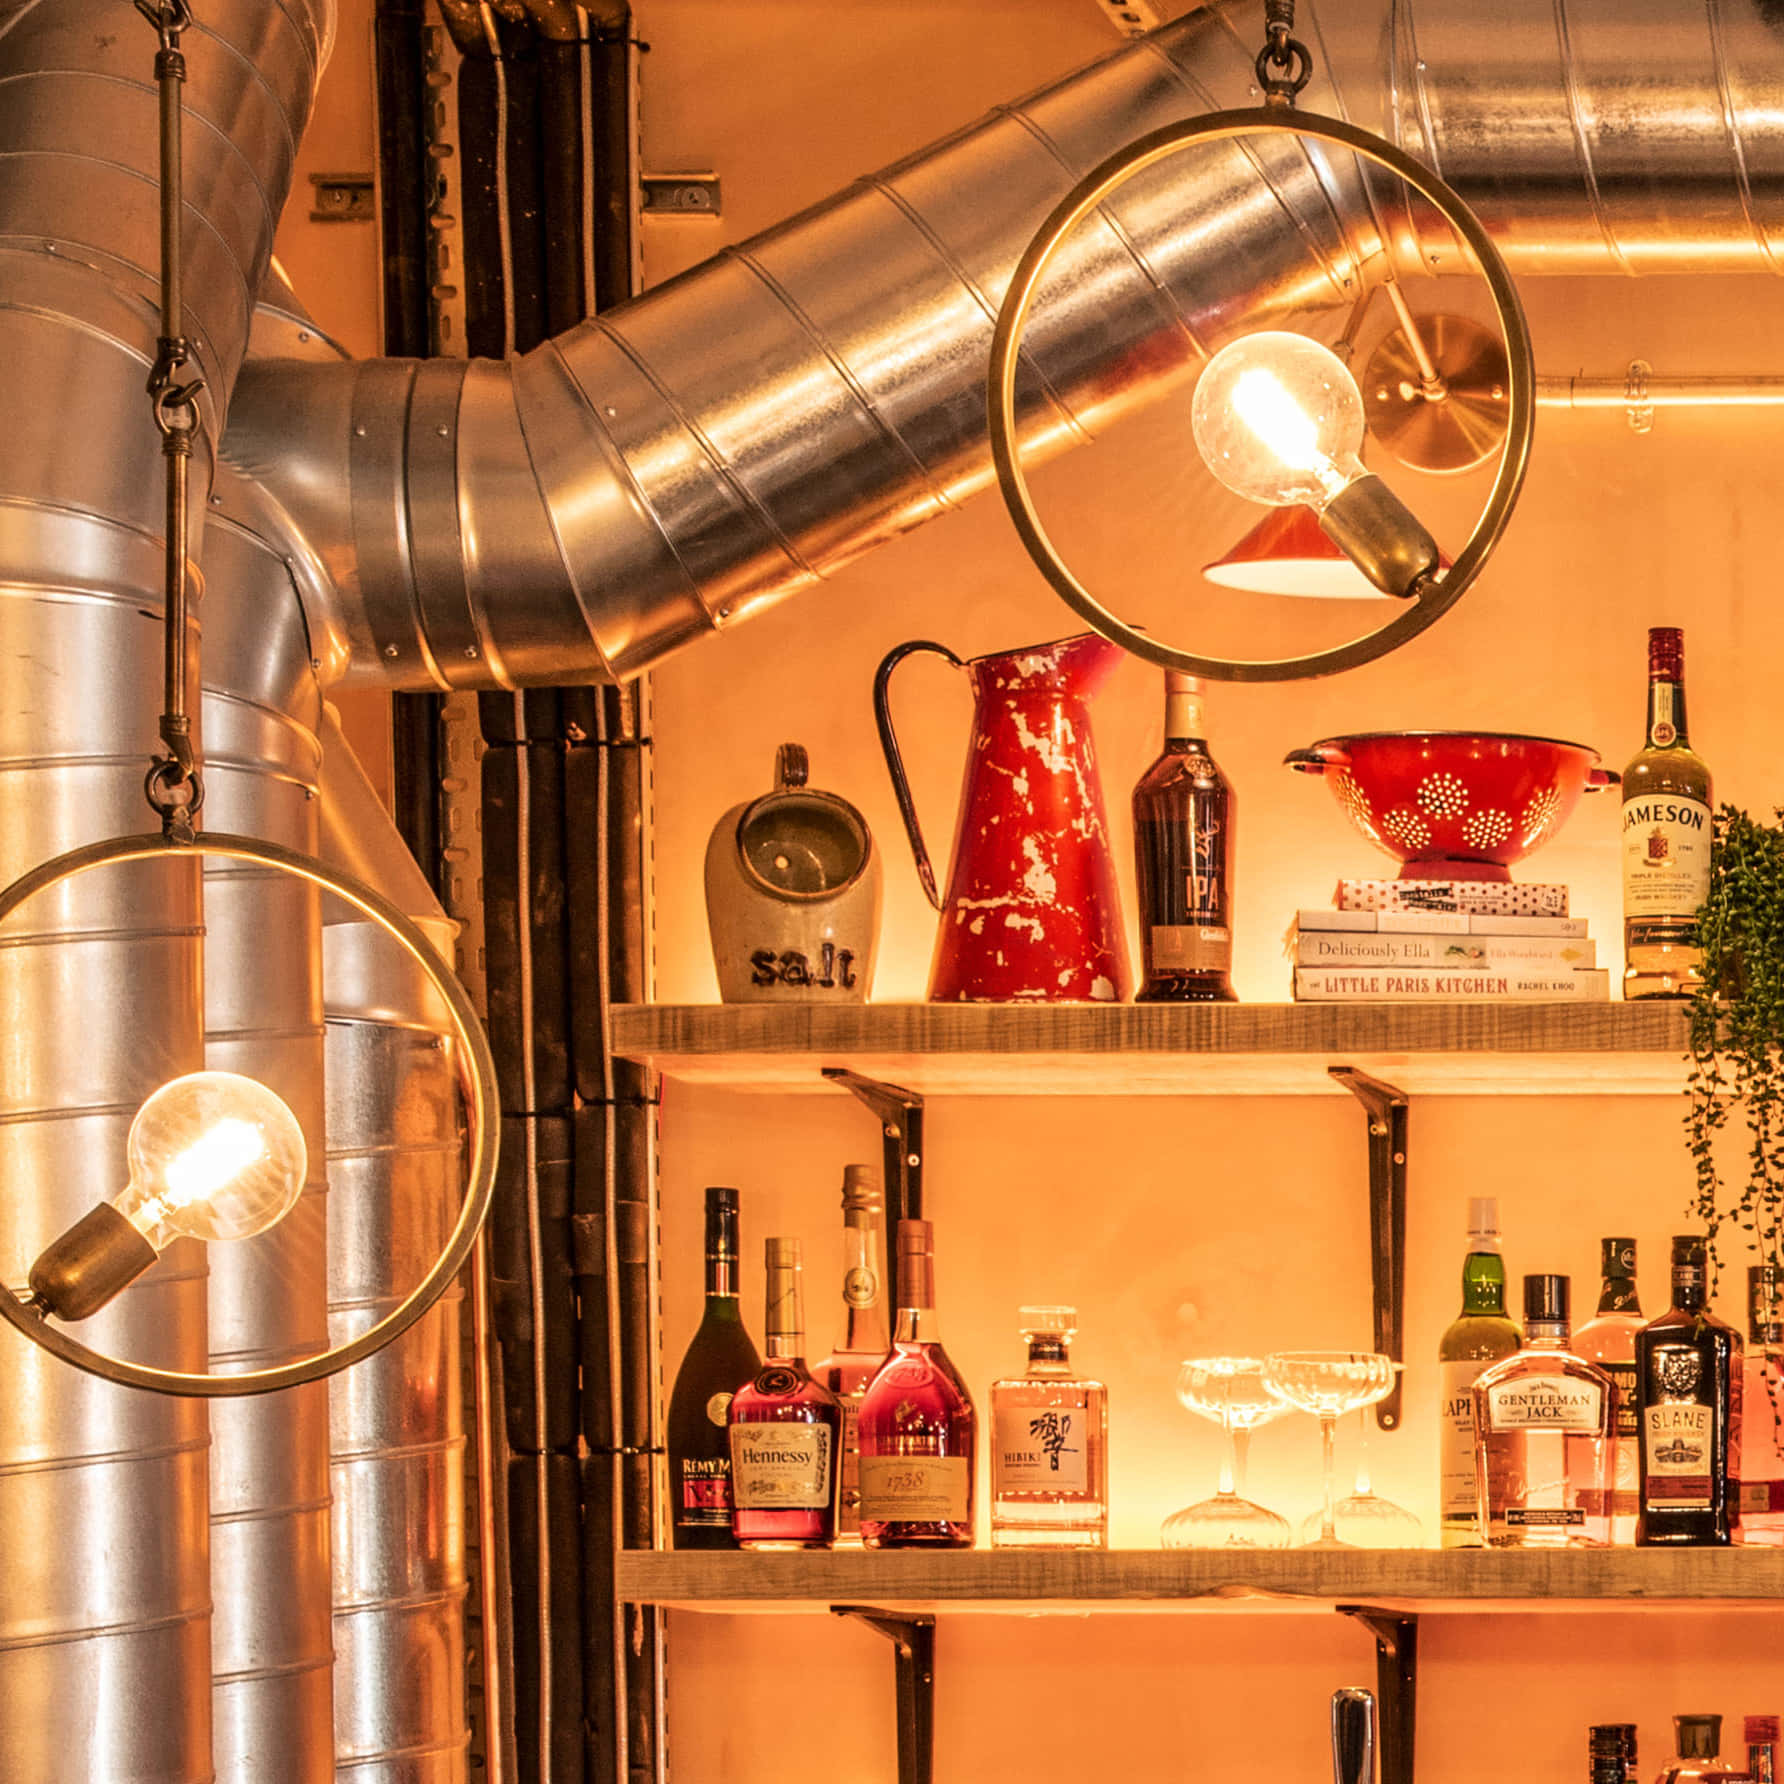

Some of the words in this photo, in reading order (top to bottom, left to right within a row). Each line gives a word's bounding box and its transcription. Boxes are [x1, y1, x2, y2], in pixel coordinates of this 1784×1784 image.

[1623, 804, 1703, 832] JAMESON
[1186, 875, 1219, 910] IPA
[1318, 941, 1400, 959] Deliciously
[1403, 943, 1430, 959] Ella
[750, 942, 857, 989] salt
[1325, 977, 1379, 993] LITTLE
[1386, 977, 1429, 993] PARIS
[1436, 977, 1508, 993] KITCHEN
[1498, 1394, 1592, 1406] GENTLEMAN
[1527, 1406, 1563, 1419] JACK
[1651, 1411, 1706, 1430] SLANE
[683, 1457, 717, 1474] RÉMY
[742, 1449, 813, 1465] Hennessy
[1004, 1452, 1041, 1464] HIBIKI
[886, 1472, 925, 1493] 1738
